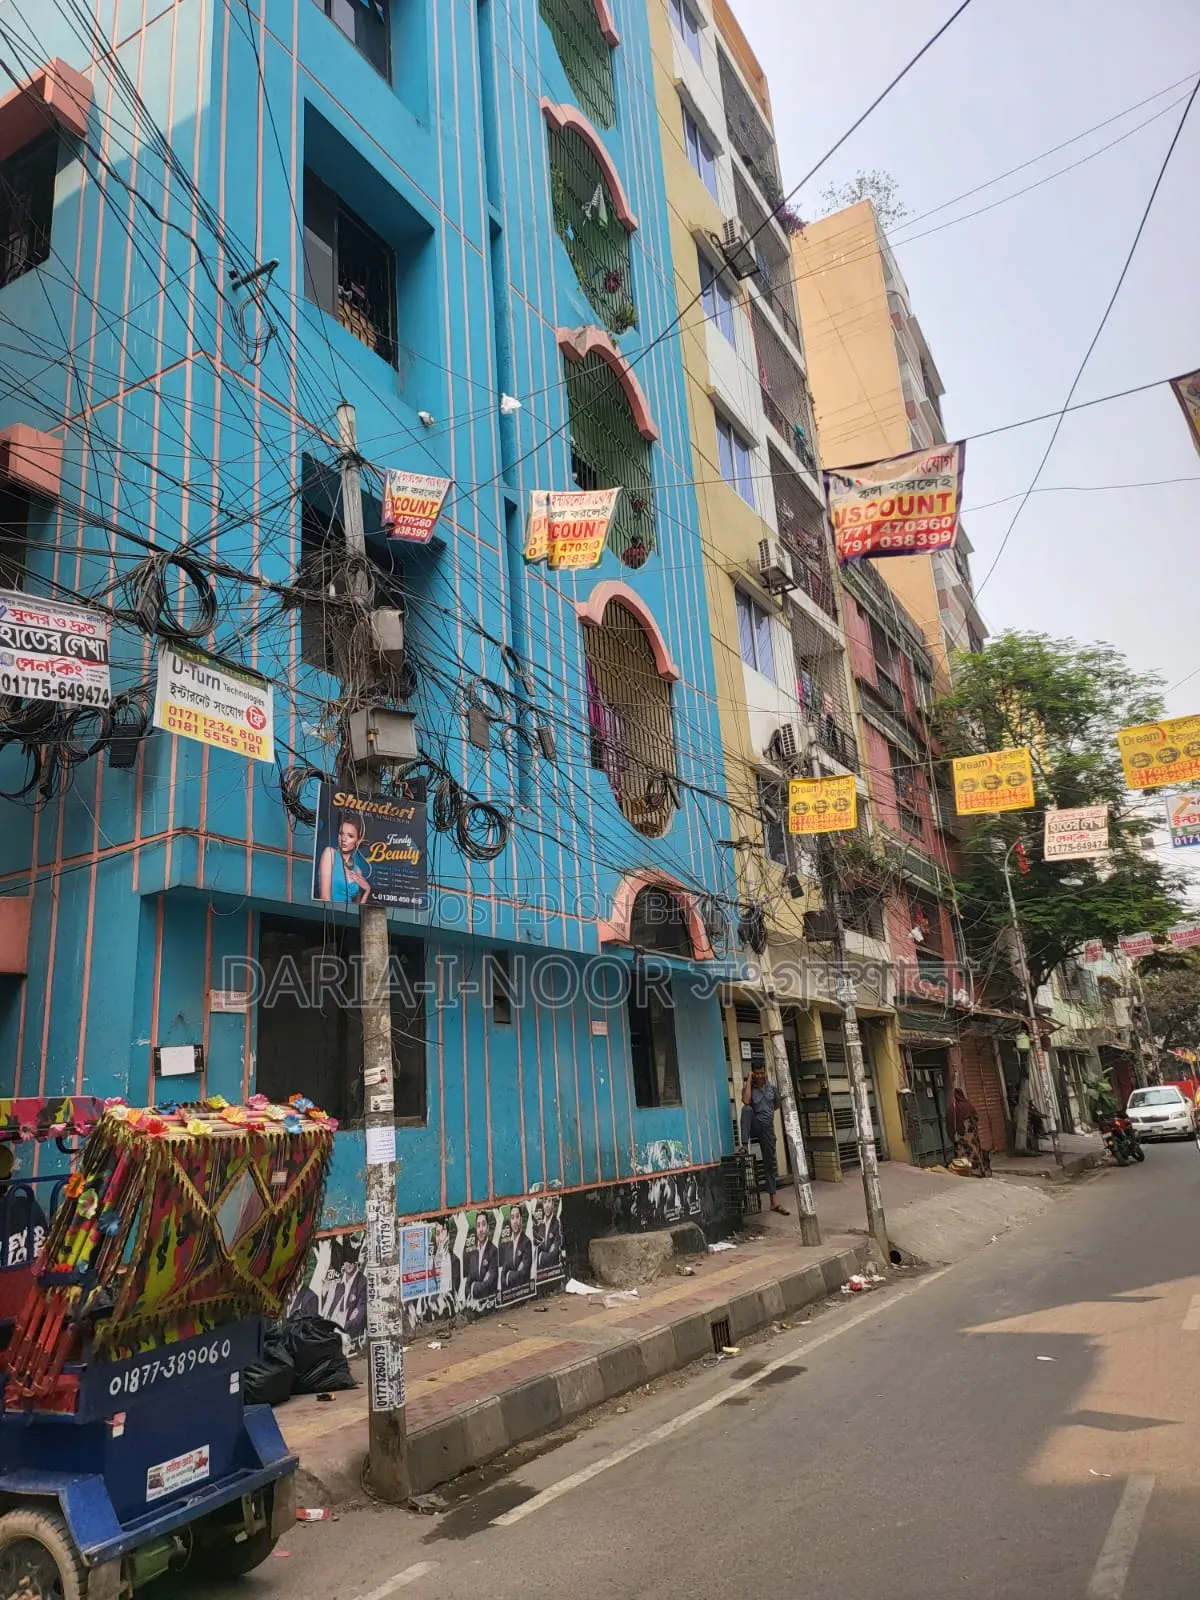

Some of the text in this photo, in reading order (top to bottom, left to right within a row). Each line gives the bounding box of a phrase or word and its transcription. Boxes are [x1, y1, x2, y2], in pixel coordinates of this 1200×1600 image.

[880, 517, 952, 533] 470360
[880, 531, 952, 548] 038399
[8, 608, 49, 626] সুন্দর
[54, 618, 66, 627] ও
[0, 625, 106, 661] হাতের লেখা
[1, 674, 110, 705] 01775-649474
[172, 655, 220, 691] U-Turn
[223, 683, 265, 707] Technologies
[169, 681, 211, 708] ইন্টারনেট
[214, 701, 245, 720] সংযোগ
[168, 717, 262, 755] 0181 5555 181
[169, 706, 263, 745] 0171 1234 800
[1123, 732, 1160, 746] Dream
[956, 759, 987, 771] Dream
[791, 785, 817, 794] Dream
[333, 792, 416, 820] Shundori
[367, 841, 420, 865] Beauty
[1047, 840, 1108, 853] 01775-649474
[109, 1339, 231, 1396] 01877-389060
[374, 1345, 388, 1407] 01773260379
